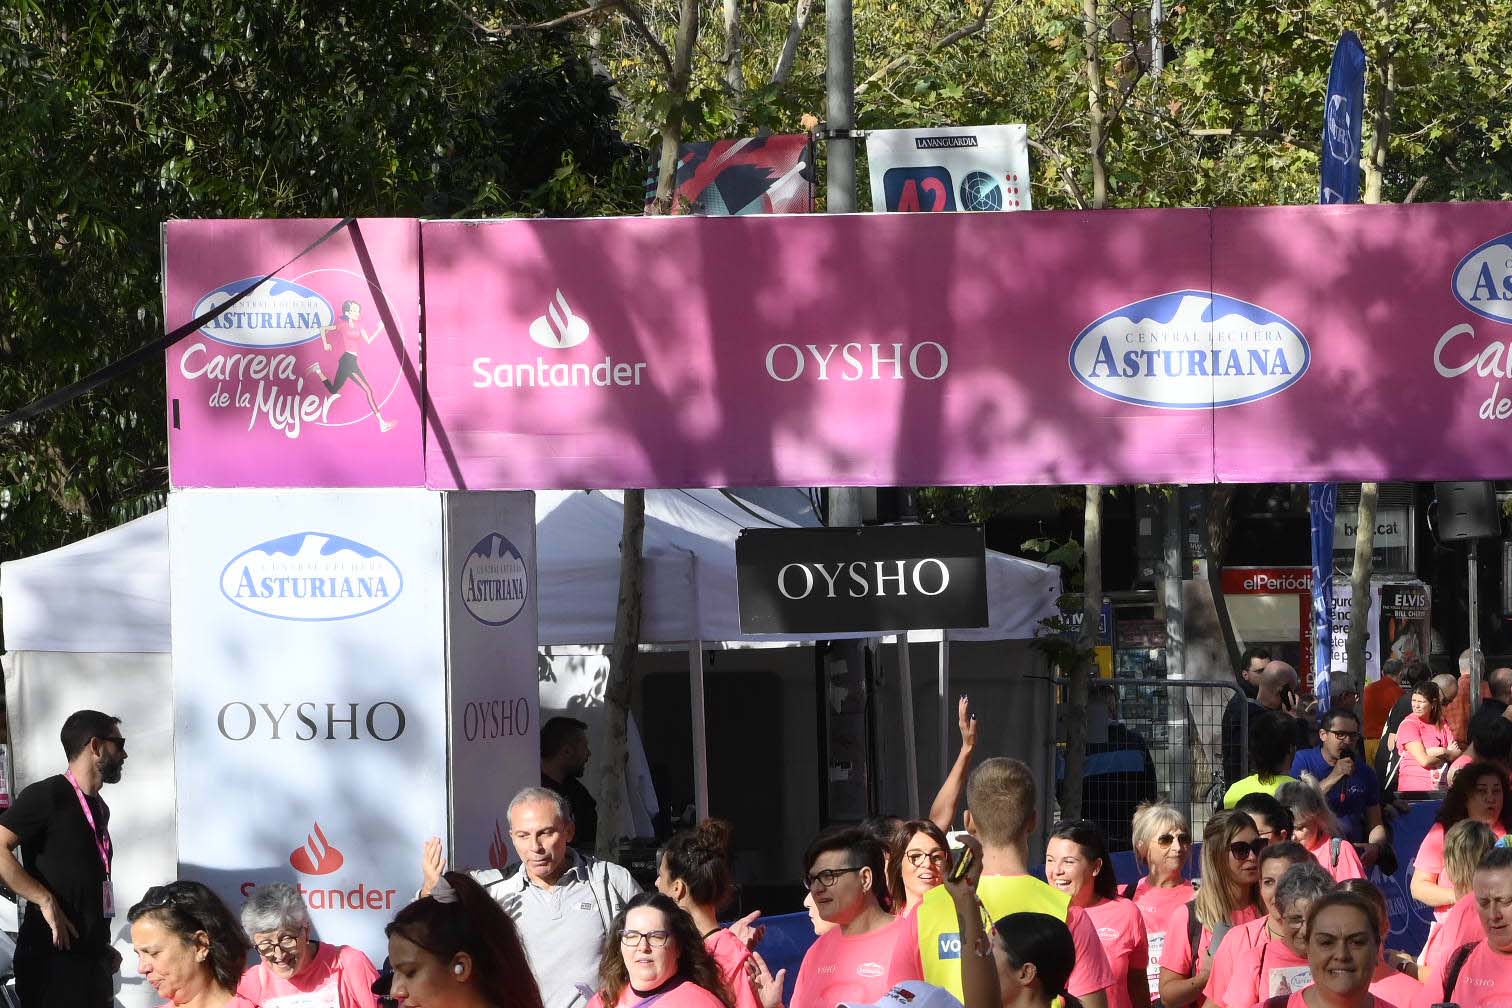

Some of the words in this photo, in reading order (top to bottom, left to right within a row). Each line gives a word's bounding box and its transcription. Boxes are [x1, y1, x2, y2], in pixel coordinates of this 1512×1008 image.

[1126, 331, 1200, 343] CENTRAL
[1209, 330, 1283, 342] LECHERA
[180, 343, 297, 380] Carrera
[473, 356, 646, 388] Santander
[765, 341, 948, 381] OYSHO
[1088, 335, 1291, 378] ASTURIANA
[209, 382, 230, 407] de
[235, 382, 251, 407] la
[248, 377, 341, 438] Mujer
[1479, 382, 1512, 420] de
[234, 565, 390, 598] ASTURIANA
[466, 568, 524, 602] ASTURIANA
[778, 558, 950, 599] OYSHO
[1395, 594, 1425, 607] ELVIS
[217, 701, 406, 741] OYSHO
[463, 697, 530, 741] OYSHO
